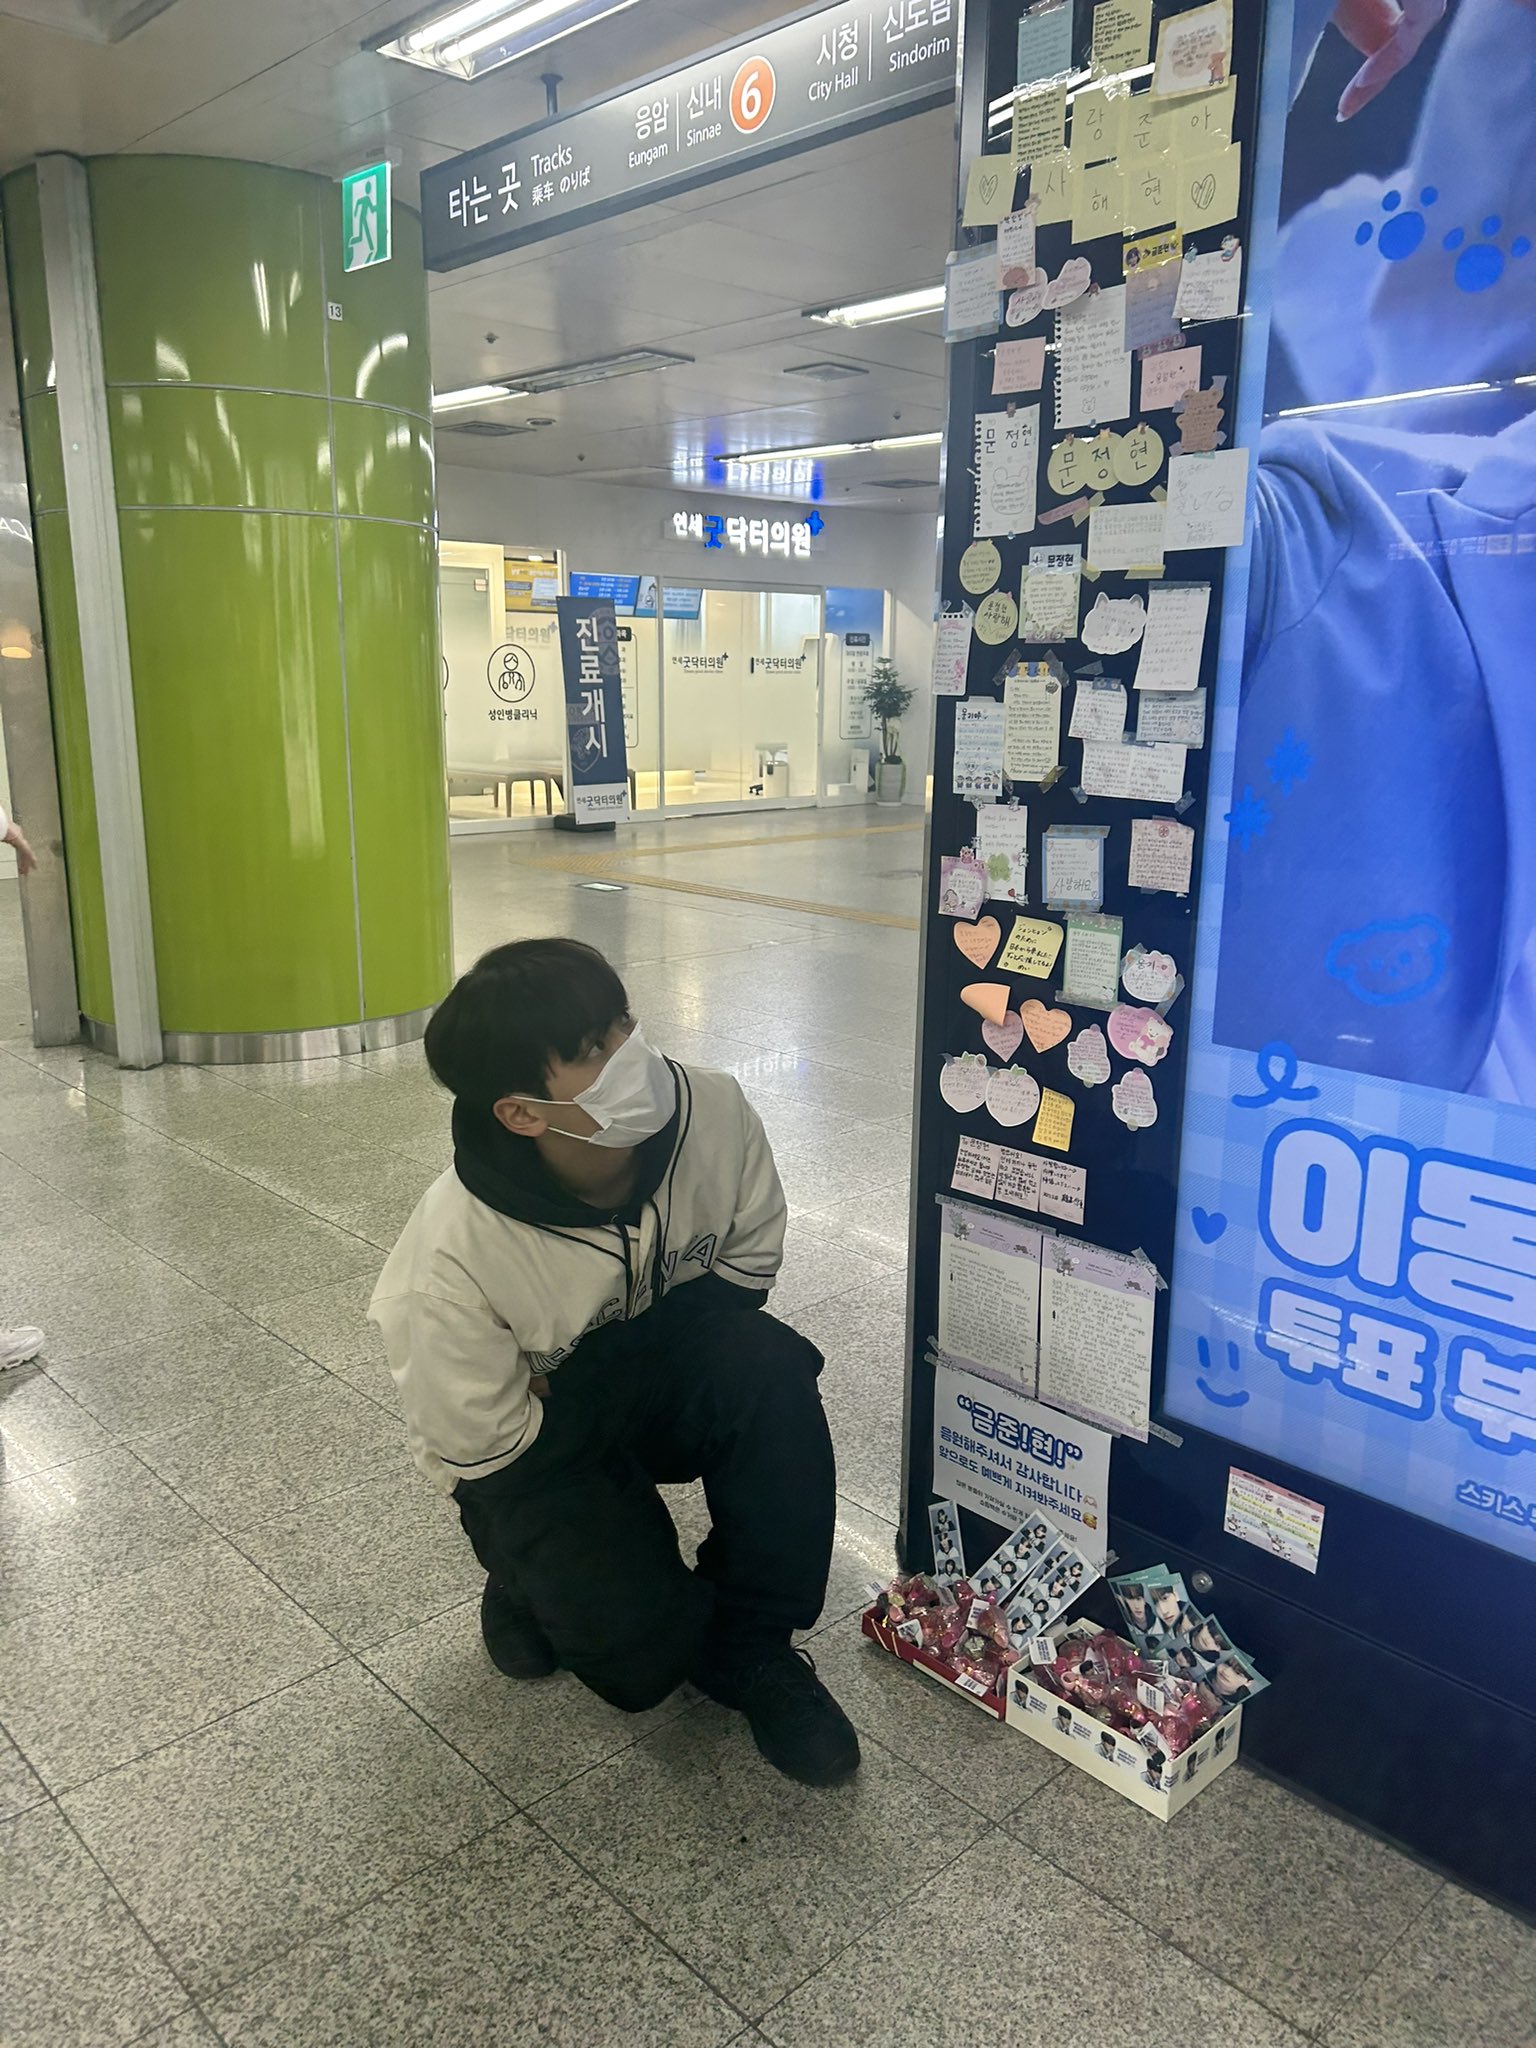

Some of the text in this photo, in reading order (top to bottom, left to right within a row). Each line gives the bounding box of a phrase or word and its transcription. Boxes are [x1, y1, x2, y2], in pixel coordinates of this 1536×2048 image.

[816, 0, 951, 66] 시청 신도림
[808, 36, 950, 101] City Hall Sindorim
[635, 71, 762, 140] 응암 신내 6
[1190, 105, 1212, 130] 아
[530, 143, 573, 177] Tracks
[628, 123, 722, 168] Eungam Sinnae
[448, 161, 522, 227] 타는 곳
[531, 164, 592, 206] 乘车 のりば
[1044, 168, 1067, 197] 사
[1140, 170, 1161, 206] 현
[329, 305, 342, 318] 13
[672, 510, 812, 558] 연세굿닥터의원
[1047, 553, 1074, 568] 문정현
[575, 616, 608, 758] 진료개시
[488, 708, 538, 721] 성인병클리닉
[1052, 876, 1092, 894] 사랑해요
[1260, 1283, 1433, 1415] 투표
[938, 1445, 1083, 1523] 앞으로도 예쁘게 지켜봐주세요
[940, 1425, 1083, 1504] 응원해주셔서 감사합니다
[1458, 1482, 1525, 1522] 스키스
